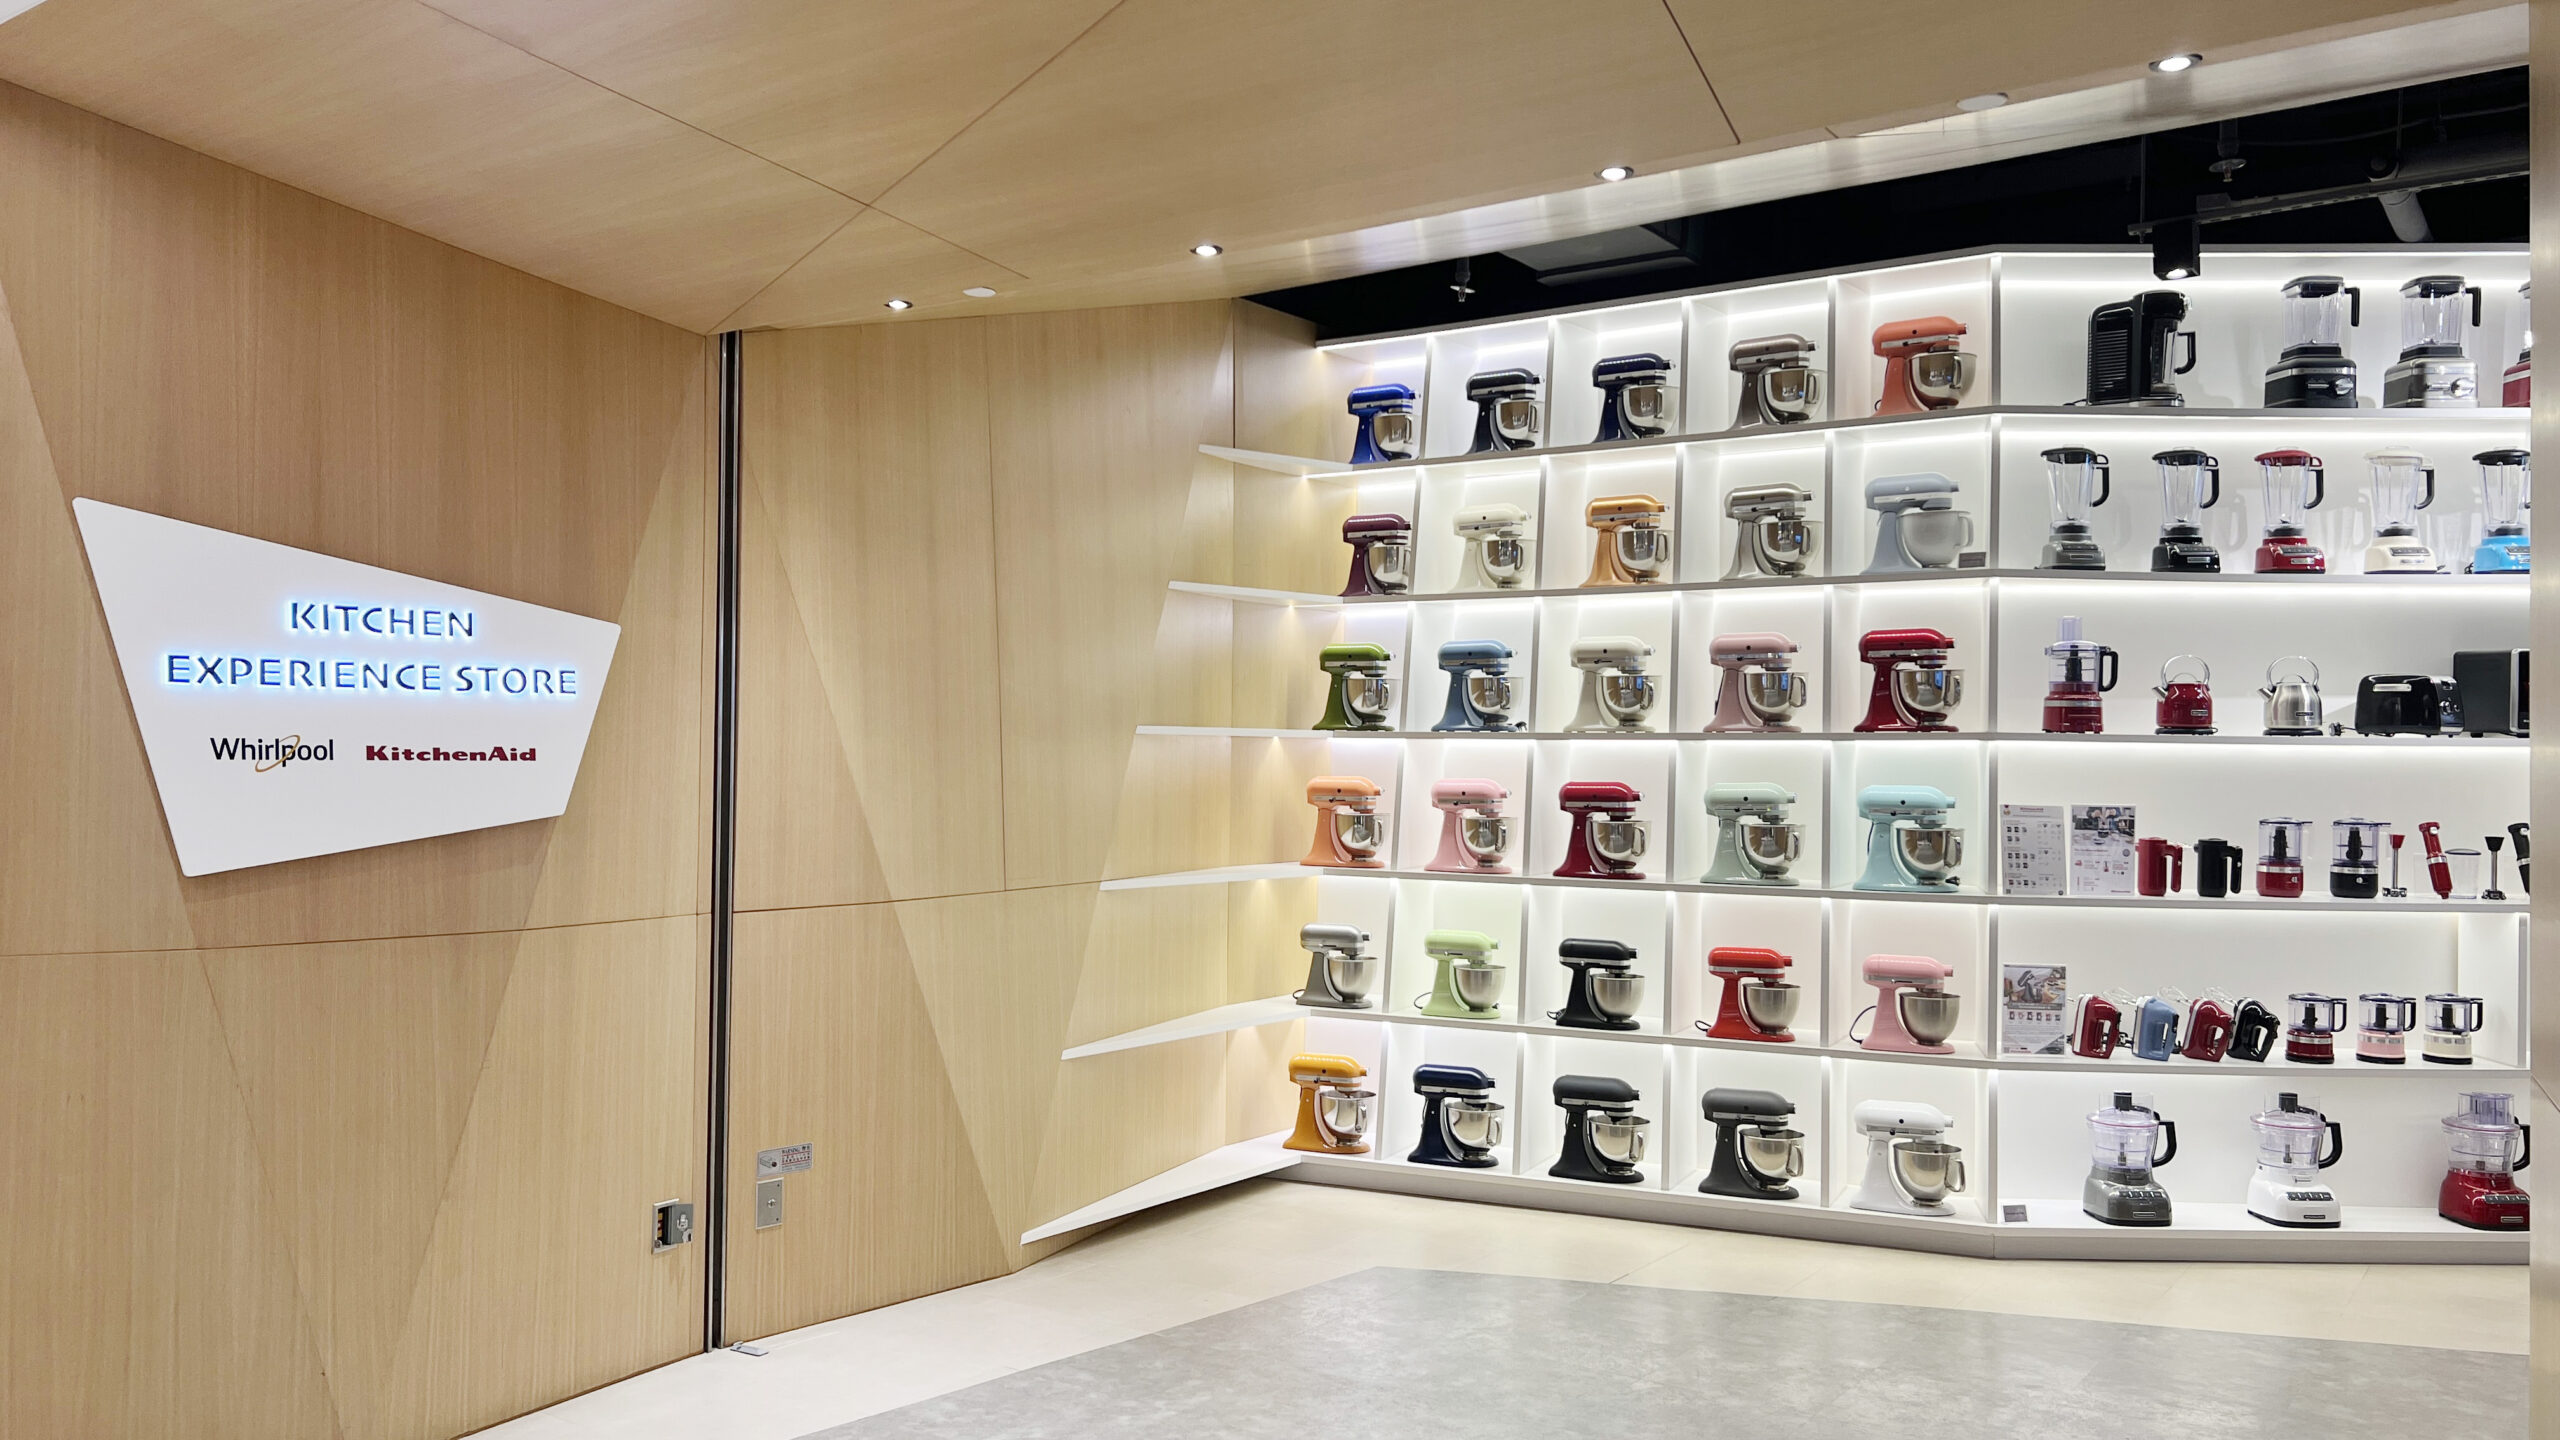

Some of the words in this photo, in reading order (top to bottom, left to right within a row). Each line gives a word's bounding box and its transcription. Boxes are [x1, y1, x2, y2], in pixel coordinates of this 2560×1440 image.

[291, 603, 474, 637] KITCHEN
[166, 655, 441, 691] EXPERIENCE
[455, 664, 577, 696] STORE
[209, 736, 334, 769] Whirlpool
[366, 745, 537, 762] KitchenAid
